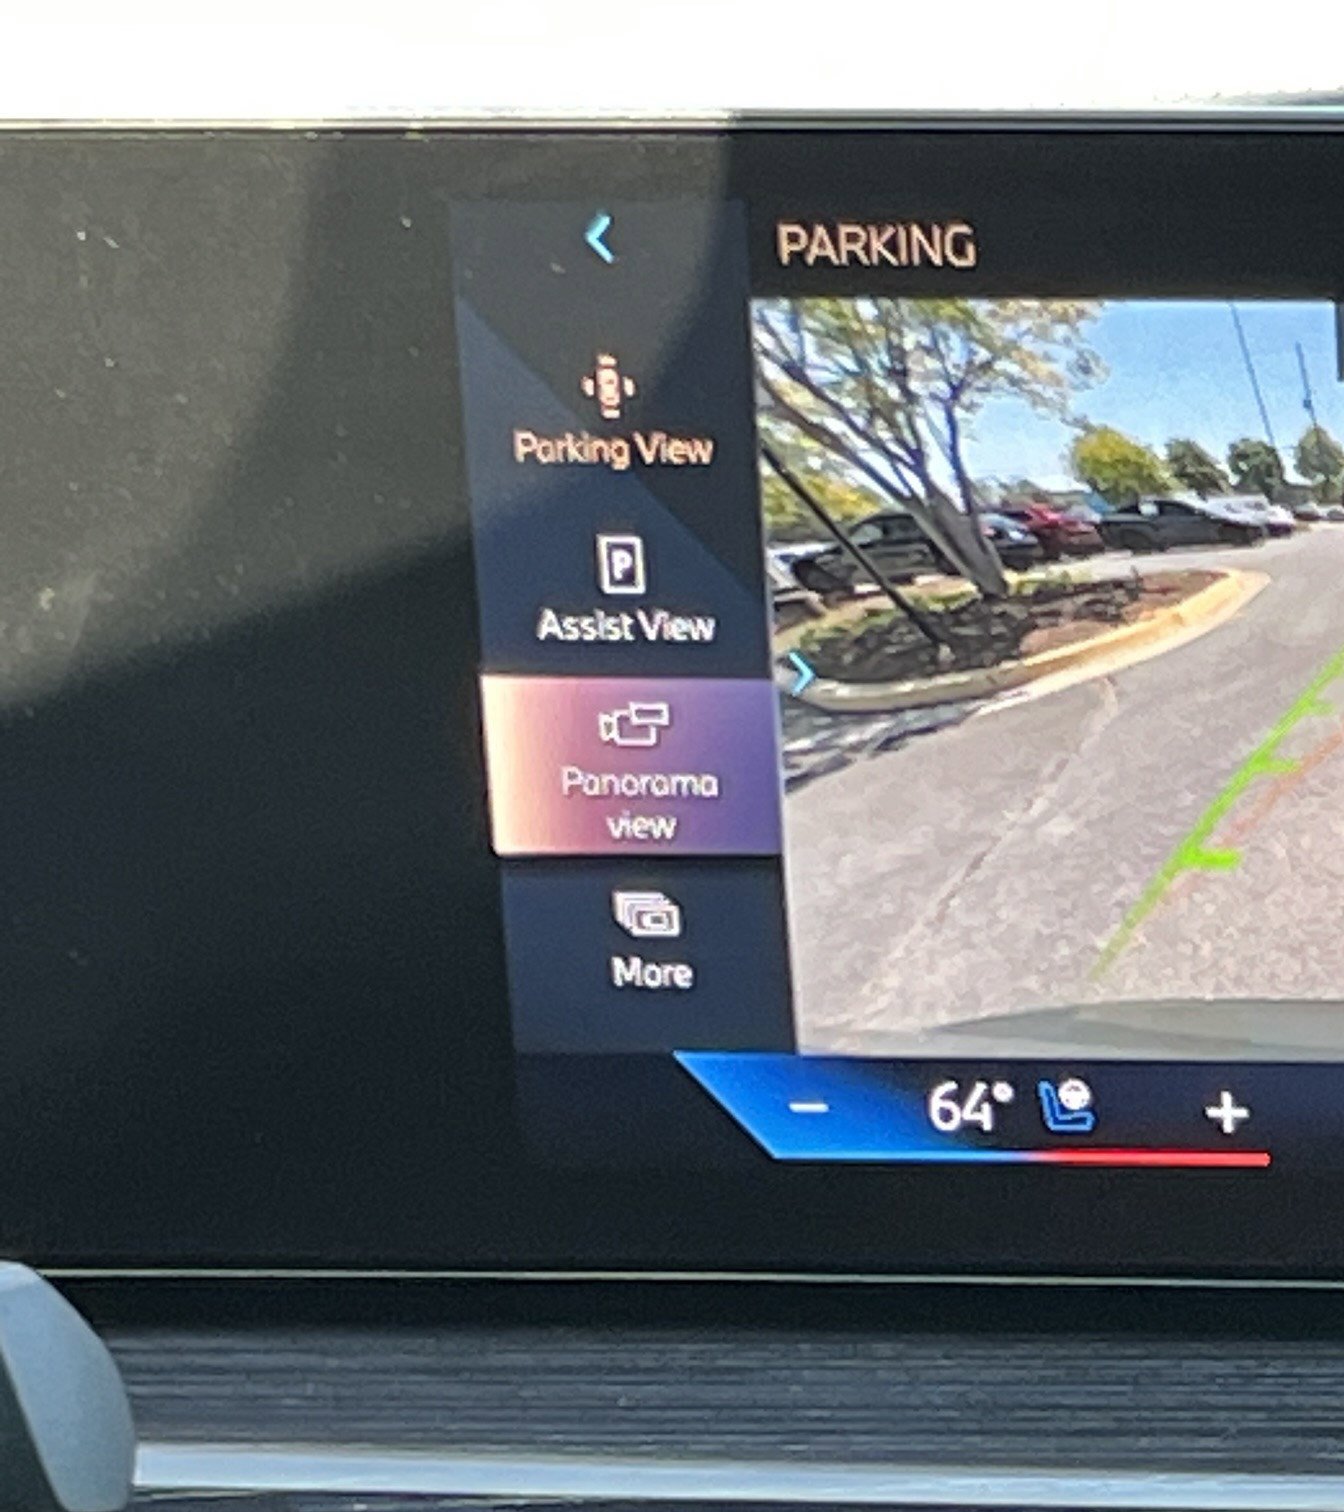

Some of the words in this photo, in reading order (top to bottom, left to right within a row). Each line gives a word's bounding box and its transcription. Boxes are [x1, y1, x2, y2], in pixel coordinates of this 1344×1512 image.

[776, 222, 977, 267] PARKING
[513, 431, 630, 470] Parking
[636, 431, 714, 465] View
[537, 609, 634, 642] Assist
[637, 609, 716, 642] View
[561, 766, 719, 799] Panorama
[606, 810, 677, 841] view
[612, 957, 693, 990] More
